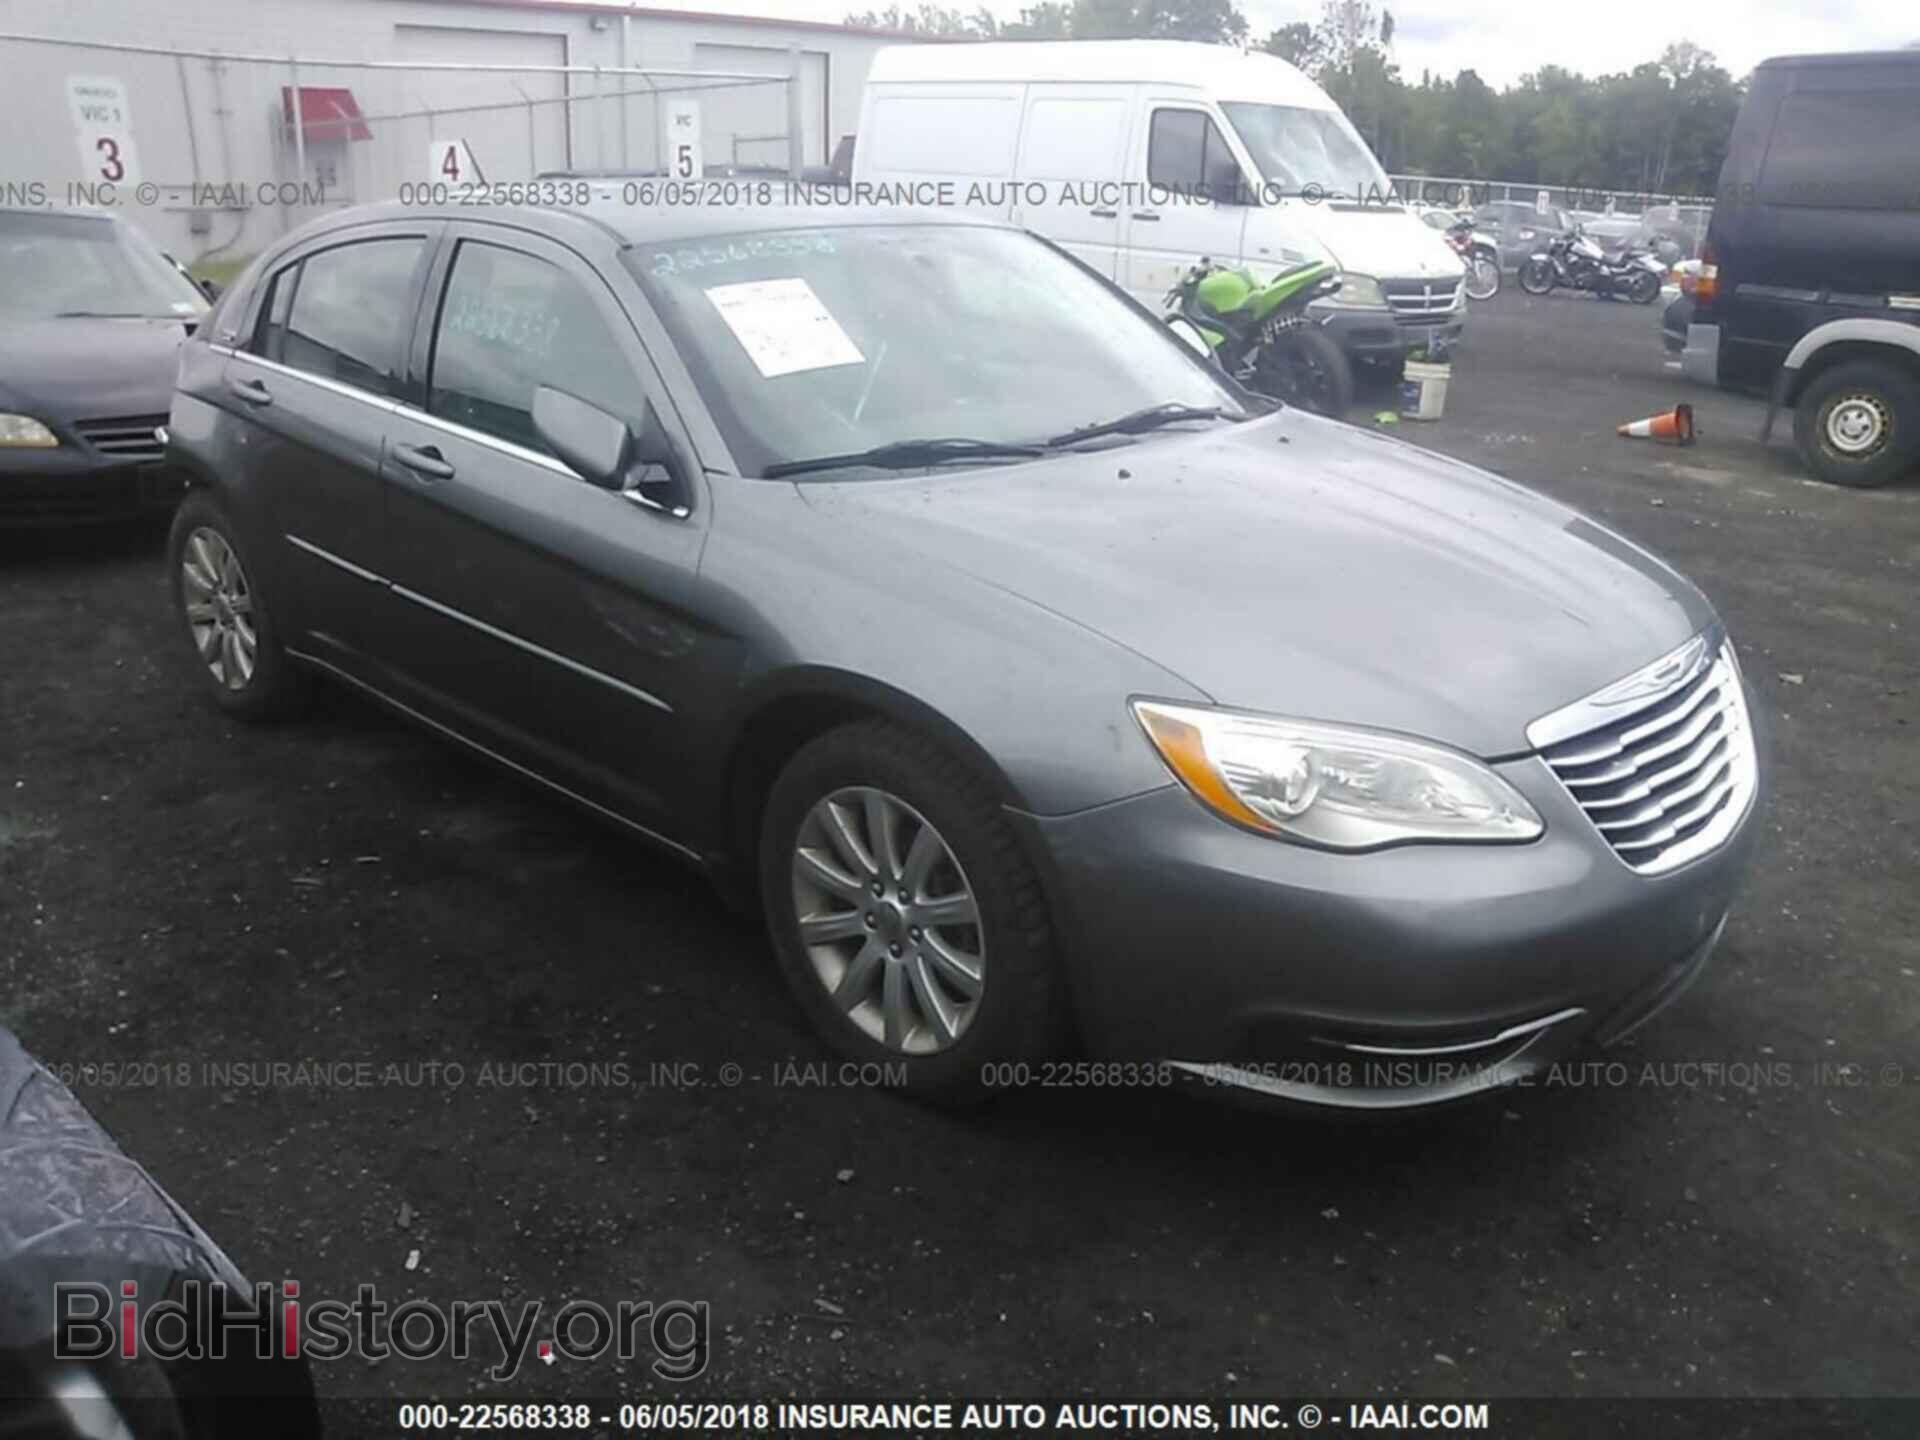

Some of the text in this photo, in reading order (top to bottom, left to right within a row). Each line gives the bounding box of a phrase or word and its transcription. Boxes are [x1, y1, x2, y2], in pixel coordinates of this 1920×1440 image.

[97, 137, 124, 182] 3
[442, 146, 460, 181] 4
[678, 145, 693, 178] 5
